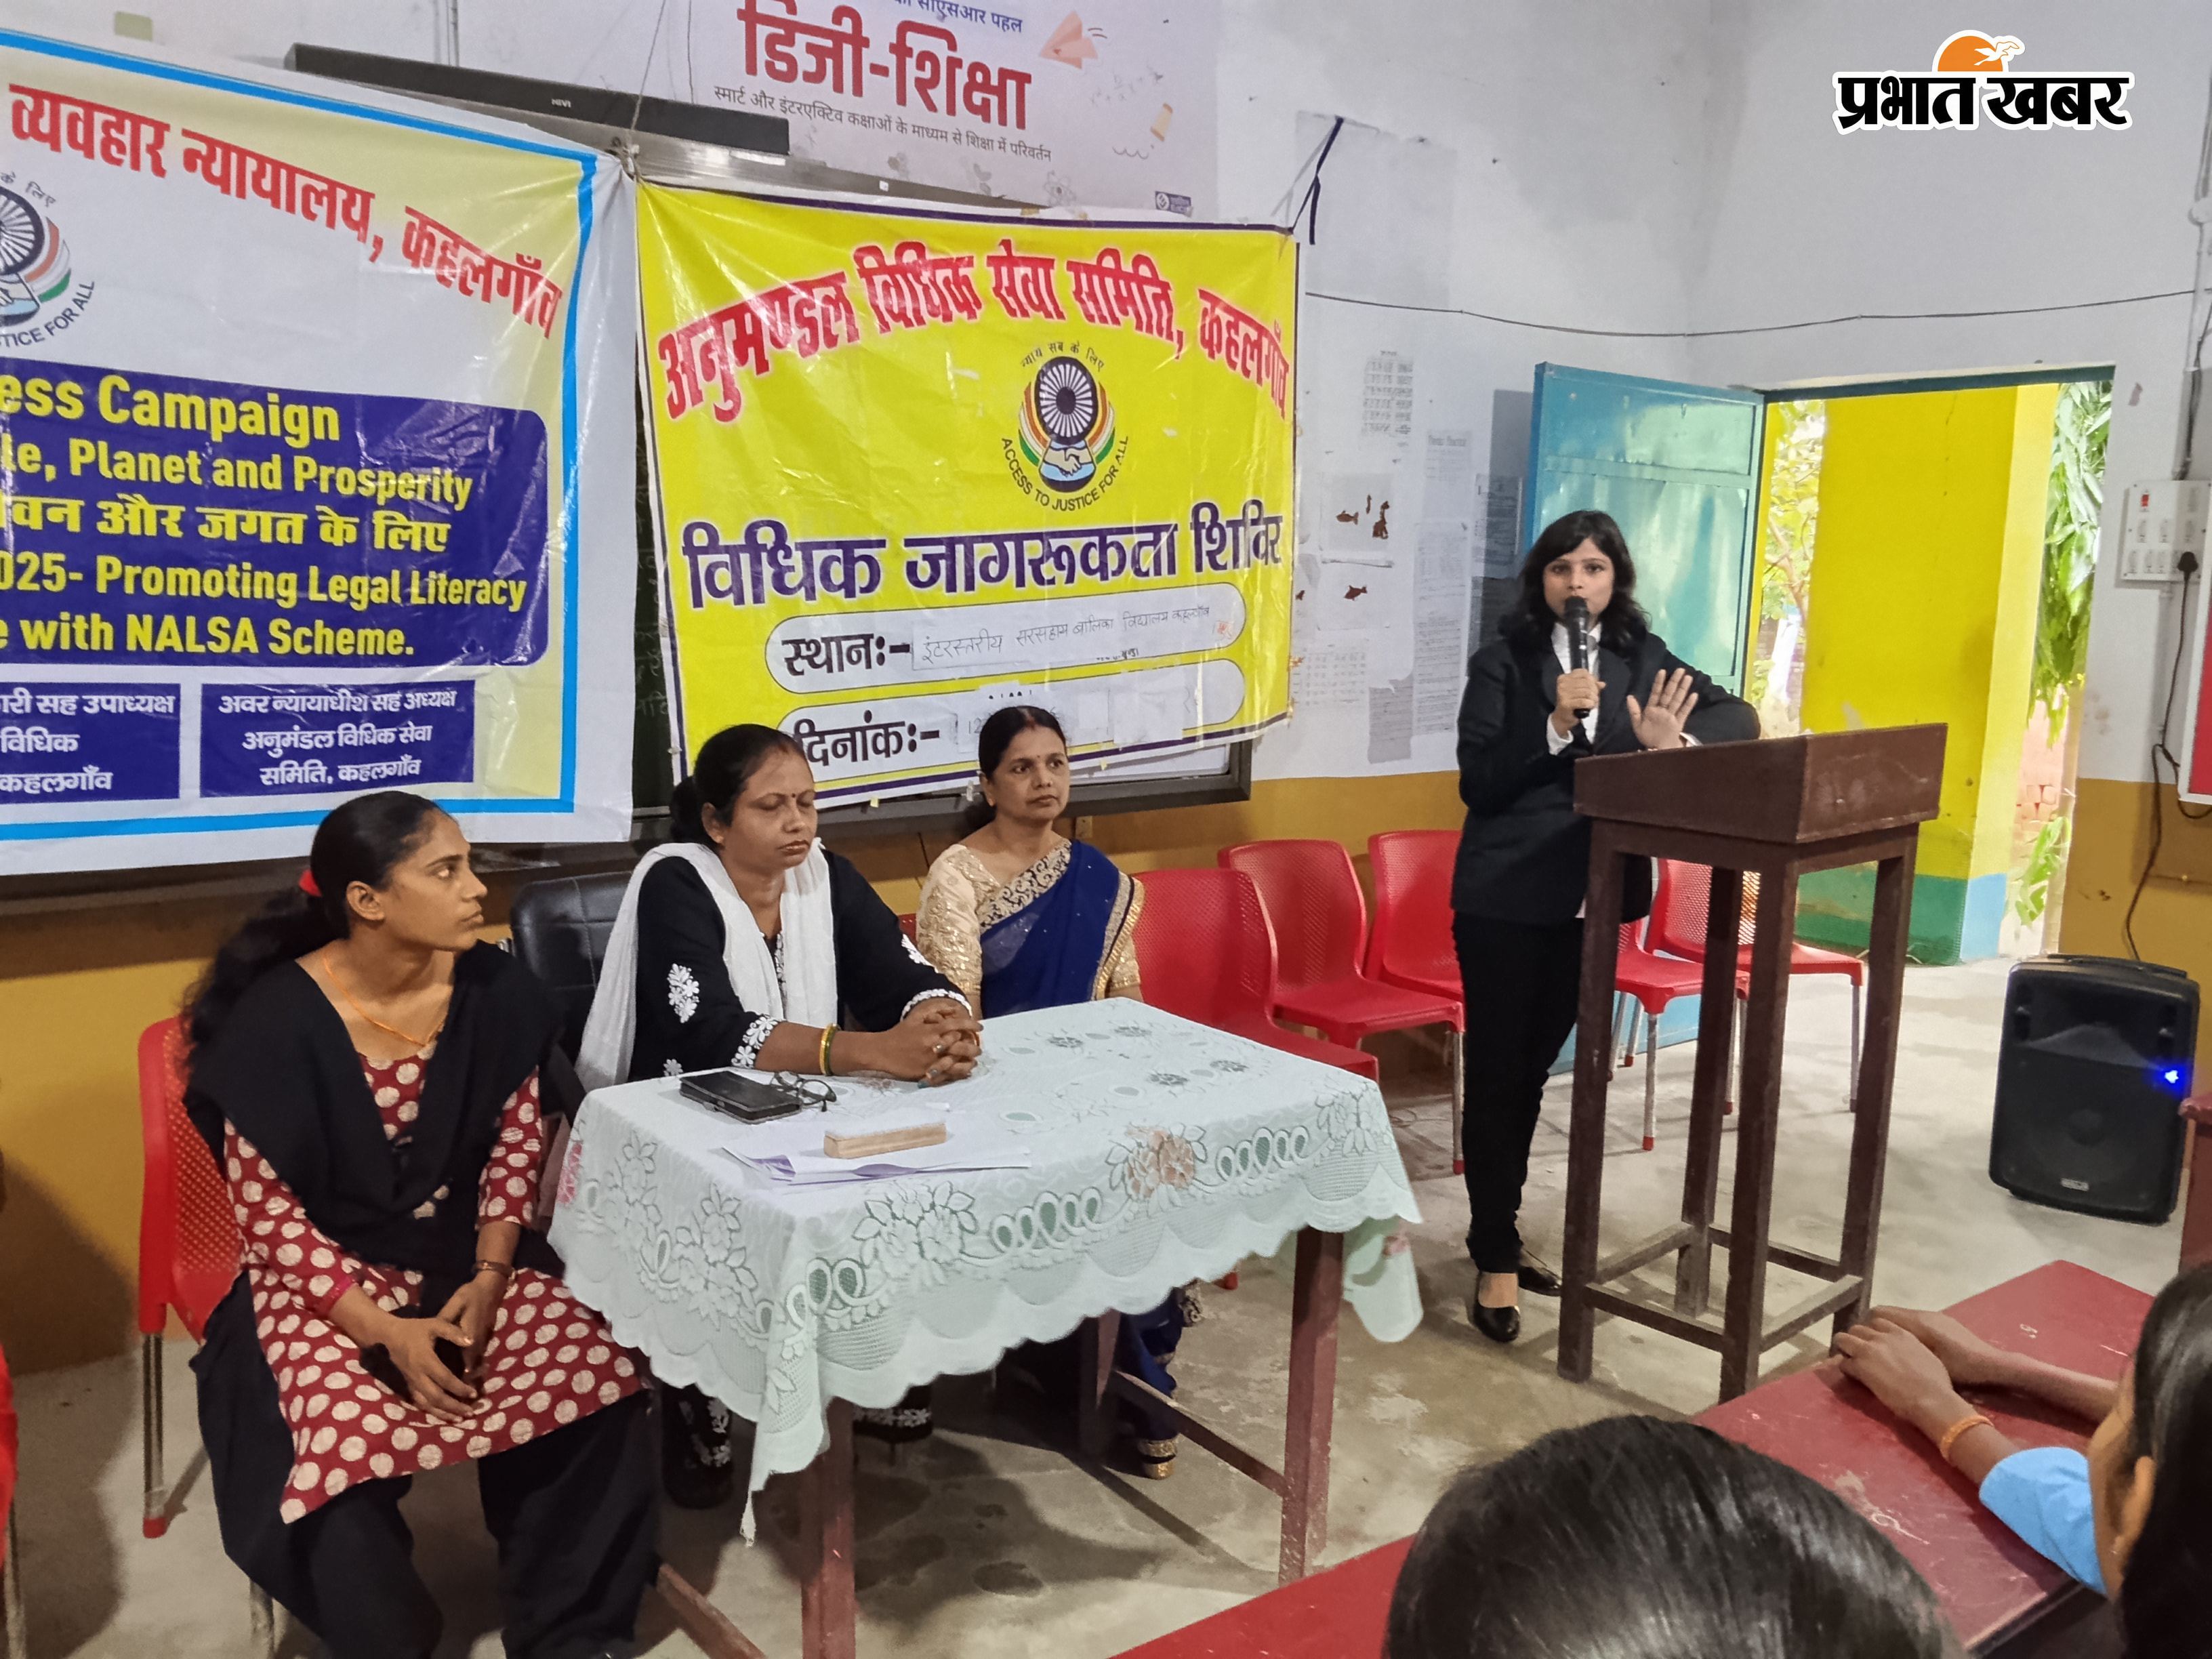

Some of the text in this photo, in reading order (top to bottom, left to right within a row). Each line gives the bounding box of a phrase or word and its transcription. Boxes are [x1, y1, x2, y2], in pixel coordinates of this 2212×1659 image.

[991, 12, 1023, 33] पहल
[737, 0, 1032, 130] डिजी-शिक्षा
[714, 85, 1052, 163] स्मार्ट और इंटरएक्टिव कक्षाओं के माध्यम से शिक्षा में परिवर्तन
[9, 83, 564, 340] व्यवहार न्यायालय, कहलगाँव
[44, 308, 80, 336] FOR
[72, 281, 95, 311] ALL
[658, 270, 861, 423] अनुमण्डल
[853, 241, 983, 334] विधिक
[986, 239, 1066, 321] सेवा
[1066, 247, 1185, 361] समिति,
[1197, 288, 1290, 420] कहलगाँव
[1048, 342, 1064, 353] सब
[1070, 340, 1080, 354] के
[98, 374, 340, 449] Campaign
[69, 437, 203, 486] Planet
[212, 453, 283, 491] and
[293, 455, 473, 512] Prosperity
[1002, 435, 1130, 512] ACCESS TO JUSTICE FOR ALL
[96, 493, 186, 538] और
[196, 506, 308, 545] जगत
[315, 505, 360, 547] के
[372, 510, 451, 552] लिए
[96, 554, 298, 609] Promoting
[309, 565, 402, 612] Legal
[410, 570, 527, 613] Literacy
[682, 519, 886, 609] विधिक
[903, 523, 1178, 594] जागरूकता
[1190, 499, 1284, 573] शिविर
[20, 611, 115, 652] with
[126, 613, 260, 655] NALSA
[268, 618, 415, 656] Scheme.
[36, 695, 79, 716] सह
[82, 695, 176, 714] उपाध्यक्ष
[219, 689, 457, 714] अवर न्यायाधीश सह अध्यक्ष
[242, 720, 433, 758] अनुमंडल विधिक सेवा
[260, 754, 422, 786] समिति, कहलगाँव
